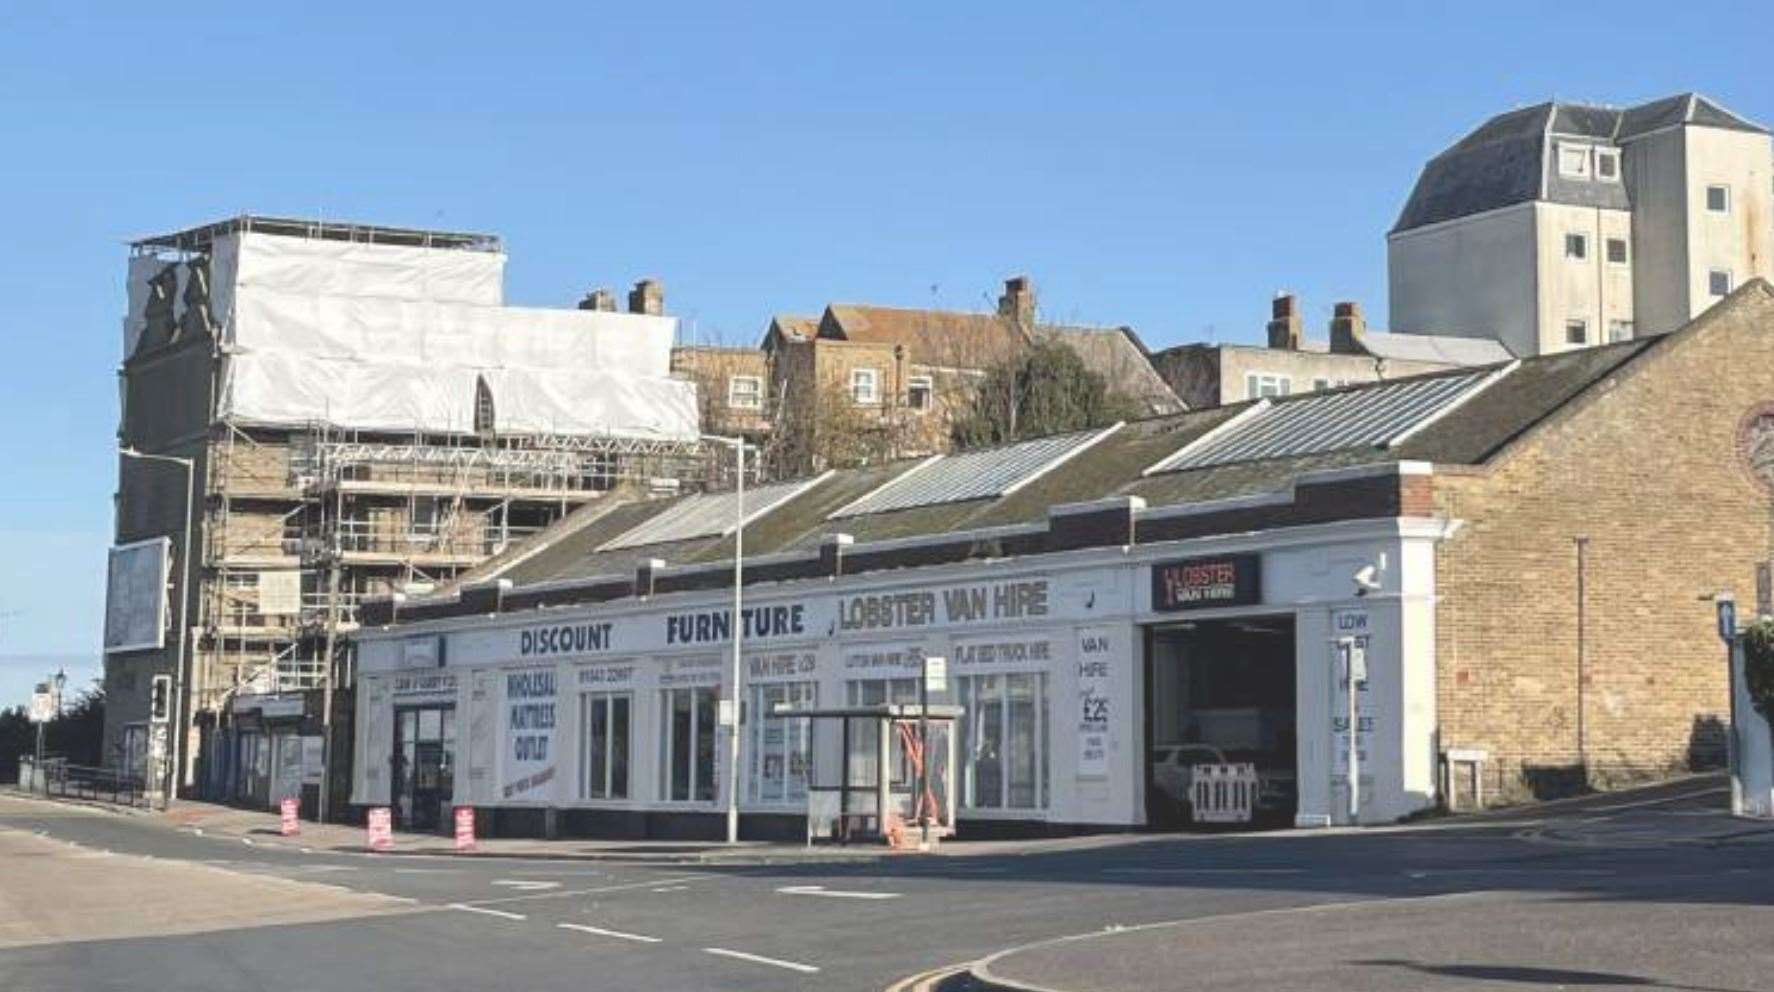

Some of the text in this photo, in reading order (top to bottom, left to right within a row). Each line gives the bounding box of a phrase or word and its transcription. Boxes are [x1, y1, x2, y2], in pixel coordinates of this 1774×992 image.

[839, 580, 1048, 630] LOBSTER VAN HIRE
[1338, 613, 1368, 630] LOW
[520, 622, 613, 655] DISCOUNT
[667, 605, 805, 644] FURNTURE
[1082, 638, 1108, 652] VAN
